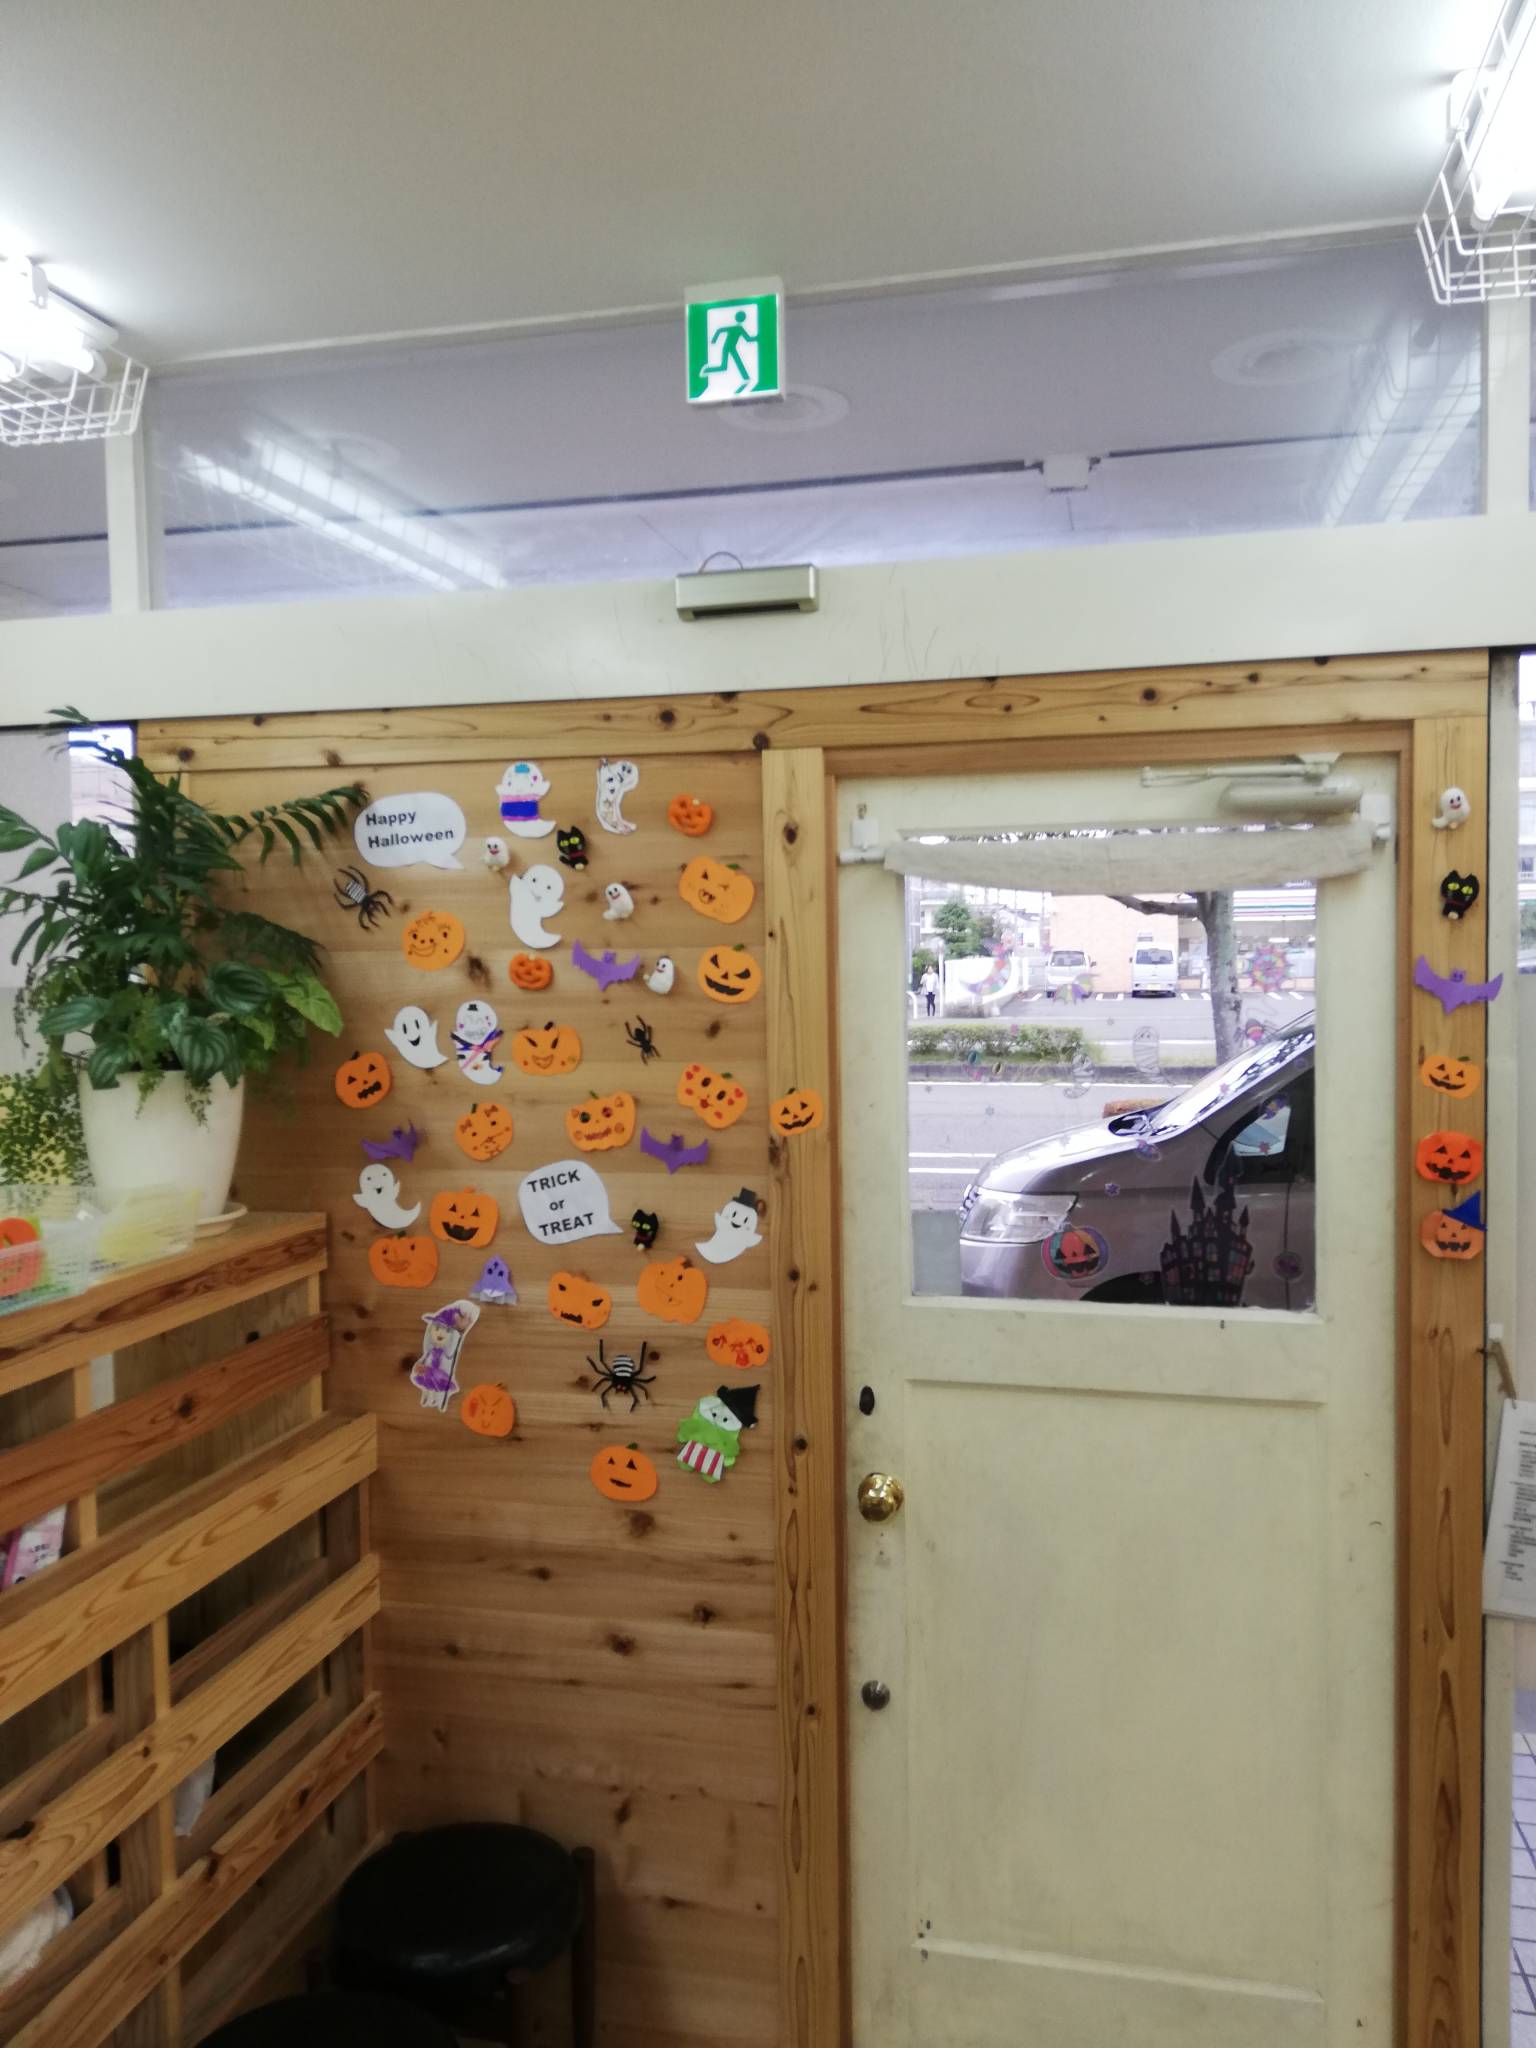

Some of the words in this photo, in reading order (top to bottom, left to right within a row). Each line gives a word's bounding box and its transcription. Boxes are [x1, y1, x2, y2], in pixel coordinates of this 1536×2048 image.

[365, 811, 417, 827] Happy
[368, 829, 454, 849] Halloween
[527, 1169, 581, 1193] TRICK
[549, 1199, 565, 1211] or
[539, 1212, 594, 1236] TREAT
